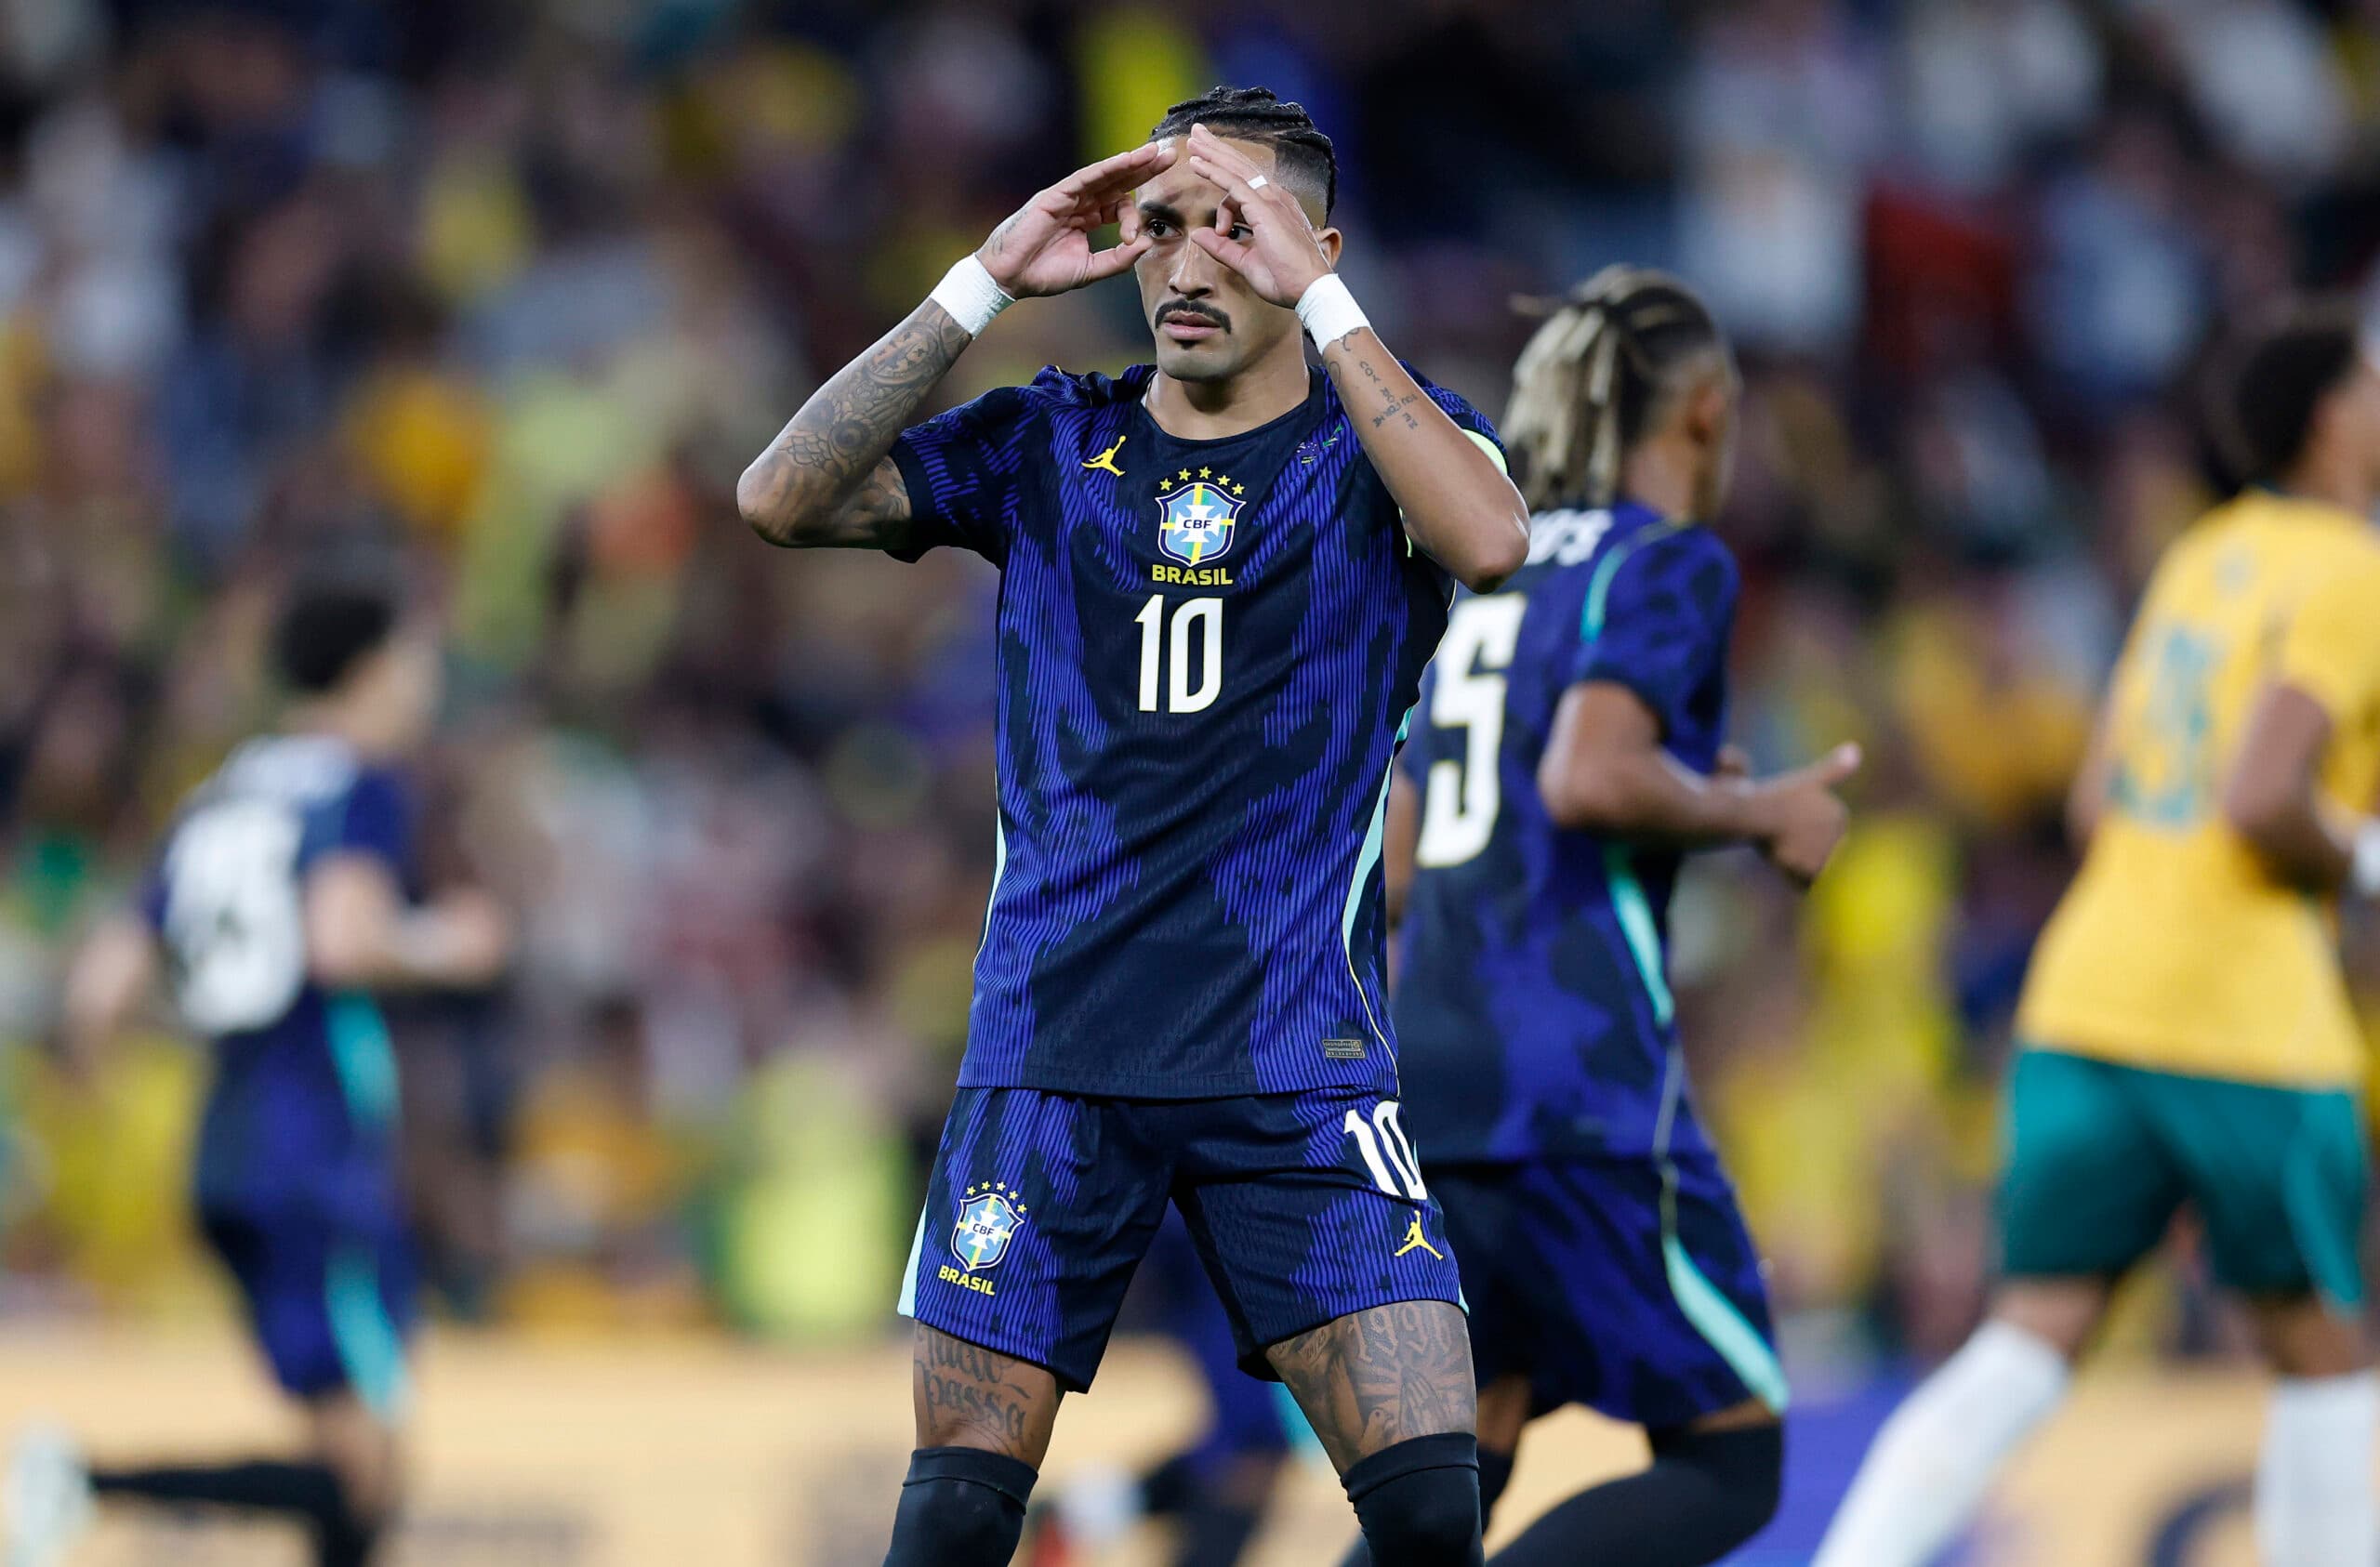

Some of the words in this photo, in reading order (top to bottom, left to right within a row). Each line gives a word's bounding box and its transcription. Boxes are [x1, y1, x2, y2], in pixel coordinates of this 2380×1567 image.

[1183, 519, 1212, 530] CBF
[1152, 564, 1233, 586] BRASIL
[1134, 594, 1223, 713] 10
[1417, 592, 1527, 867] 5
[1343, 1100, 1427, 1200] 10
[972, 1223, 995, 1236] CBF
[938, 1265, 996, 1296] BRASIL
